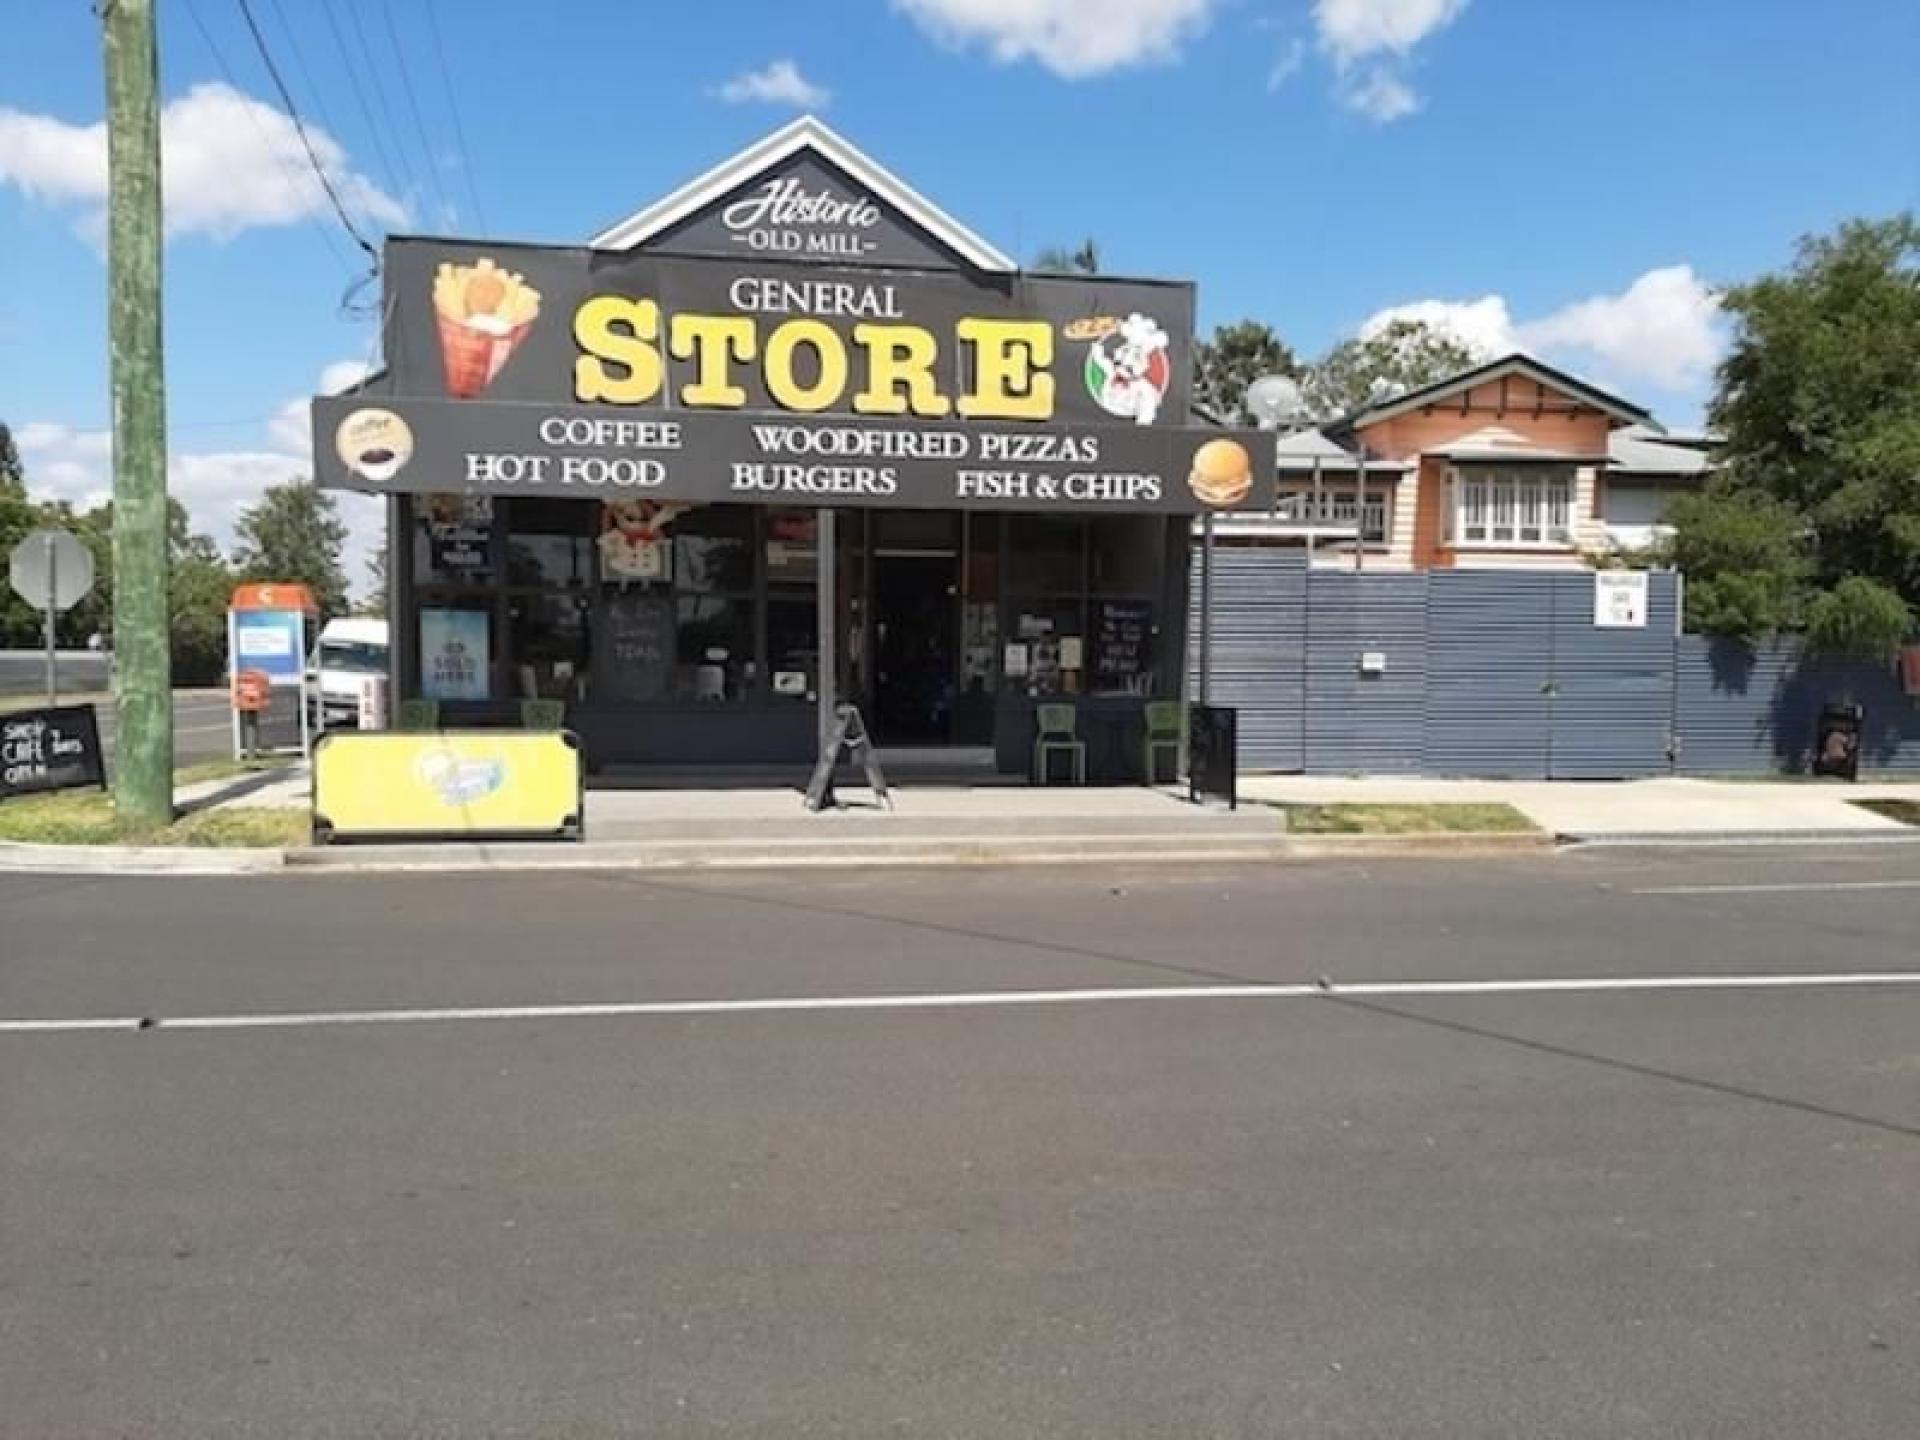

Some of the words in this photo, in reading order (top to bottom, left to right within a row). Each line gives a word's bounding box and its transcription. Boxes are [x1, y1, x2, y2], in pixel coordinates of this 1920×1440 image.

[722, 177, 882, 229] Historic
[729, 277, 904, 318] GENERAL
[574, 296, 1055, 420] STORE
[539, 419, 681, 450] COFFEE
[752, 425, 969, 461] WOODFIRED
[979, 435, 1099, 463] PIZZAS
[465, 454, 550, 482] HOT
[561, 457, 667, 487] FOOD
[730, 463, 897, 495] BURGERS
[956, 470, 1028, 498] FISH
[1035, 474, 1058, 499] &
[1062, 473, 1162, 502] CHIPS
